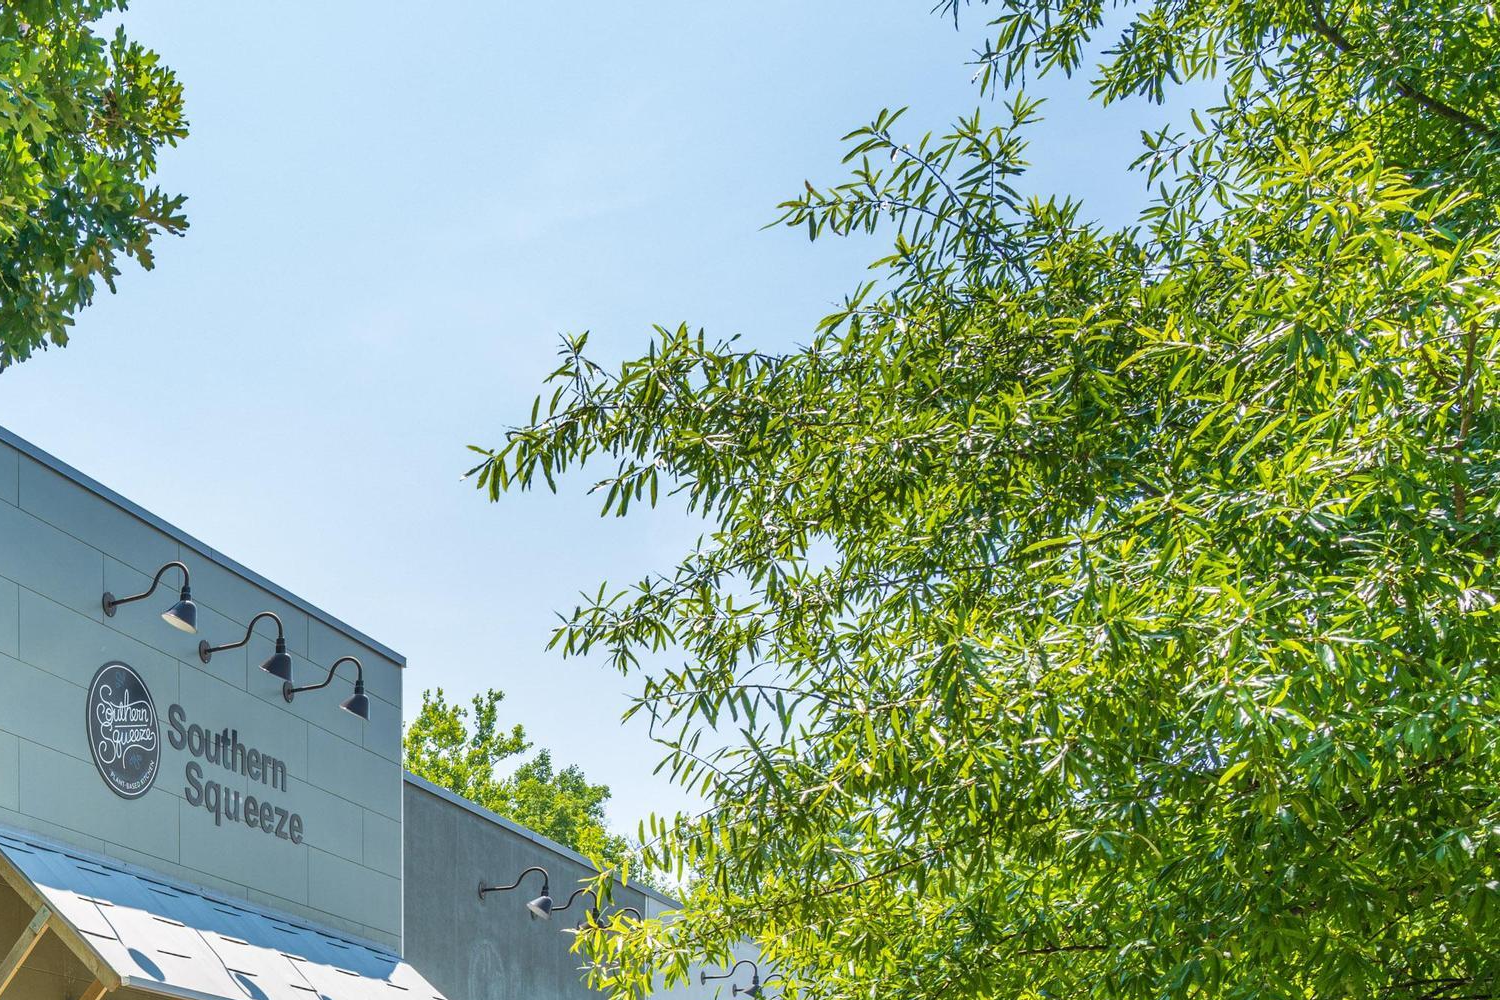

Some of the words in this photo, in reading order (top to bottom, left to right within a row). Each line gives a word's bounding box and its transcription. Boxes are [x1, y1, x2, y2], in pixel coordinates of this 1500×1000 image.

[97, 684, 153, 727] Southern
[99, 721, 157, 769] Squeeze
[167, 703, 287, 793] Southern
[184, 760, 304, 845] Squeeze
